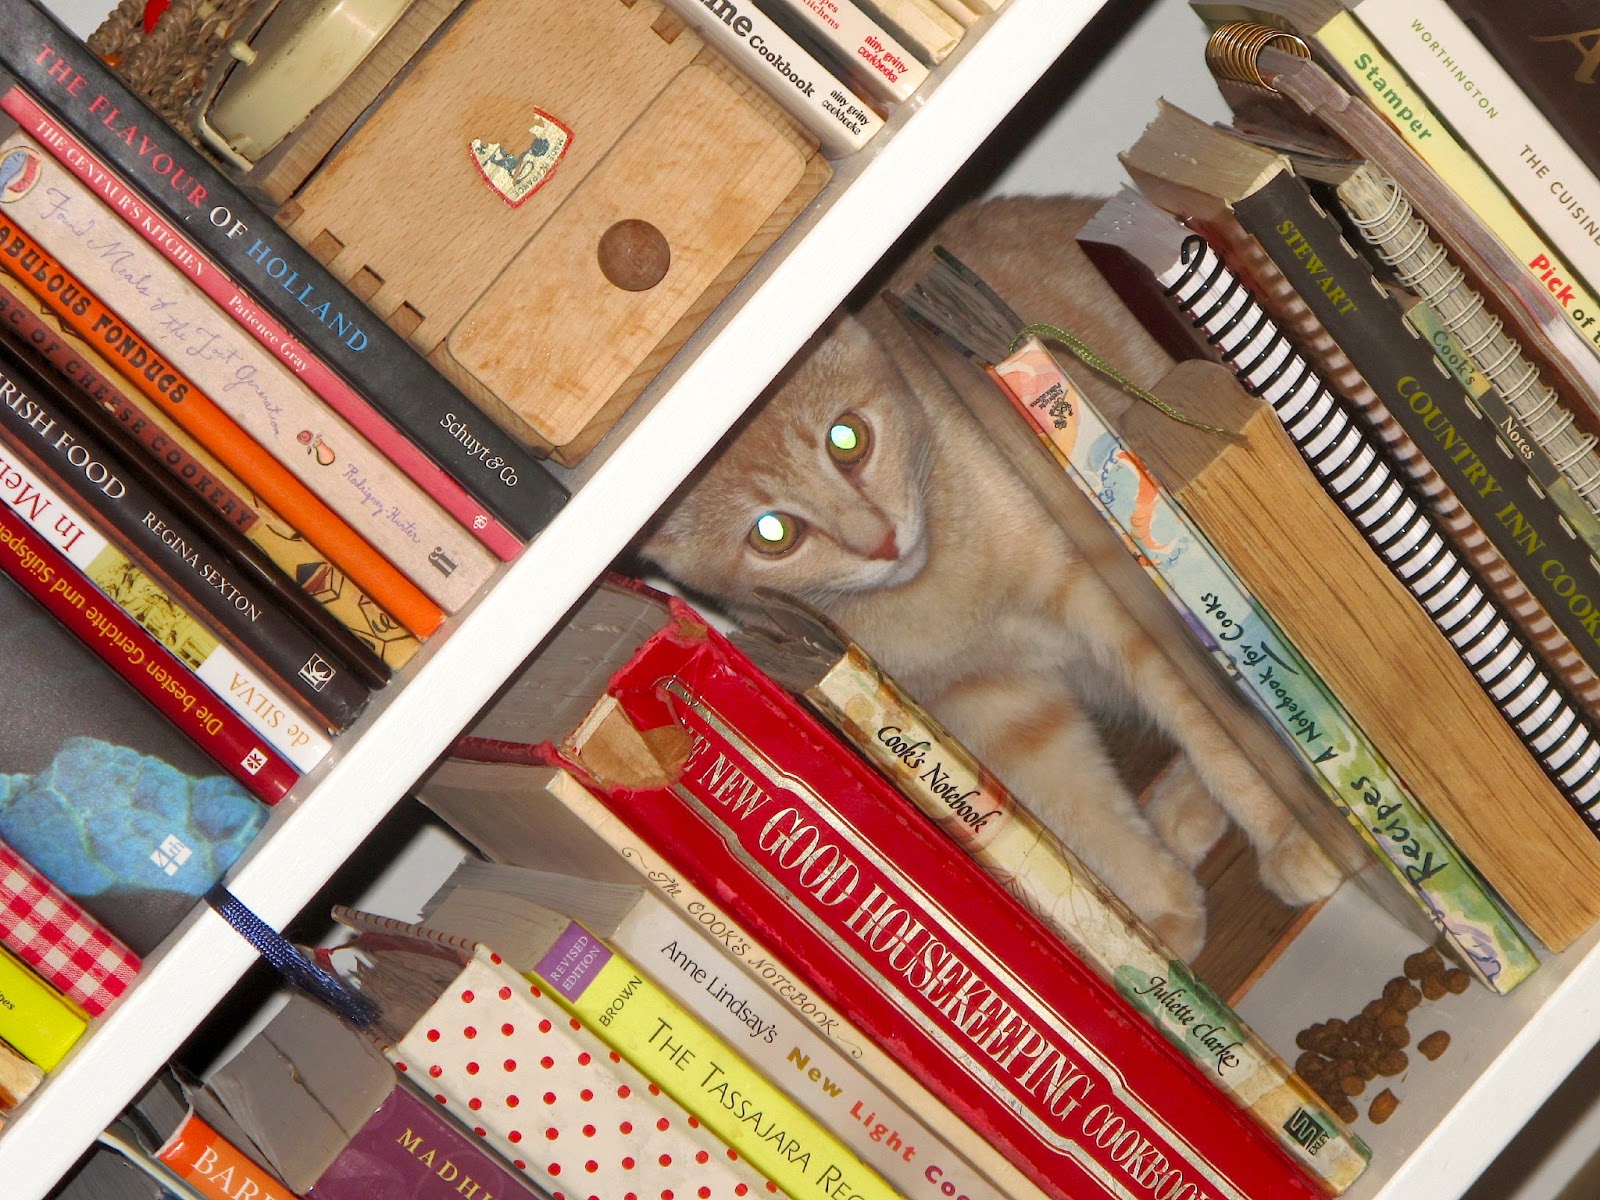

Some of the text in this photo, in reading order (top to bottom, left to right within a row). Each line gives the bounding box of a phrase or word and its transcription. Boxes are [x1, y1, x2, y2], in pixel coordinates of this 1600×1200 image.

[750, 34, 815, 98] Cookbook
[857, 46, 899, 84] cookbooks
[865, 35, 909, 75] nitty gritty
[1411, 19, 1498, 118] WORTHINGTON
[821, 98, 862, 136] cookbooks
[830, 88, 871, 127] nitty gritty
[1354, 53, 1432, 141] Stamper
[34, 44, 369, 353] THE FLAVOUR OF HOLLAND
[1520, 144, 1550, 179] THE
[36, 118, 311, 373] THE CENTAUR'S KITCHEN Patience Gray
[41, 187, 95, 238] Found
[87, 238, 151, 298] Meals
[159, 313, 188, 342] the
[185, 326, 244, 367] Lost
[1277, 220, 1359, 317] STEWART
[1528, 253, 1596, 329] Pick of
[92, 313, 189, 404] FONDUES
[1432, 330, 1535, 461] Cook's Notes
[31, 329, 60, 353] OF
[65, 360, 147, 434] CHEESE
[151, 436, 252, 527] COOKERY
[439, 412, 518, 488] Schuyt & Co
[0, 372, 262, 623] RISH FOOD REGINA SEXTON
[54, 513, 85, 552] In
[1396, 376, 1600, 648] COUNTRY INN COOK
[50, 577, 86, 609] und
[85, 605, 146, 666] Gerichte
[146, 660, 197, 711] besten
[195, 703, 224, 736] Die
[229, 671, 310, 747] de SILVA
[1200, 591, 1449, 890] Recipes A Notebook for Cooks
[877, 726, 1240, 1076] Cook's Notebook Juliette Clarke
[550, 935, 590, 984] REVISED
[561, 945, 602, 992] EDITION
[649, 869, 841, 1036] The COOK'S NOTEBOOK
[697, 752, 1209, 1200] NEW GOOD HOUSEKEEPING COOKBOO
[598, 975, 643, 1028] BROWN
[660, 940, 779, 1044] Anne Lindsay's
[646, 1017, 696, 1072] THE
[700, 1061, 811, 1173] TASSAJARA
[786, 1046, 843, 1099] New
[850, 1100, 916, 1163] Light
[190, 1144, 277, 1200] BAR
[396, 1127, 493, 1200] MADH
[1308, 1132, 1331, 1156] EXLEY
